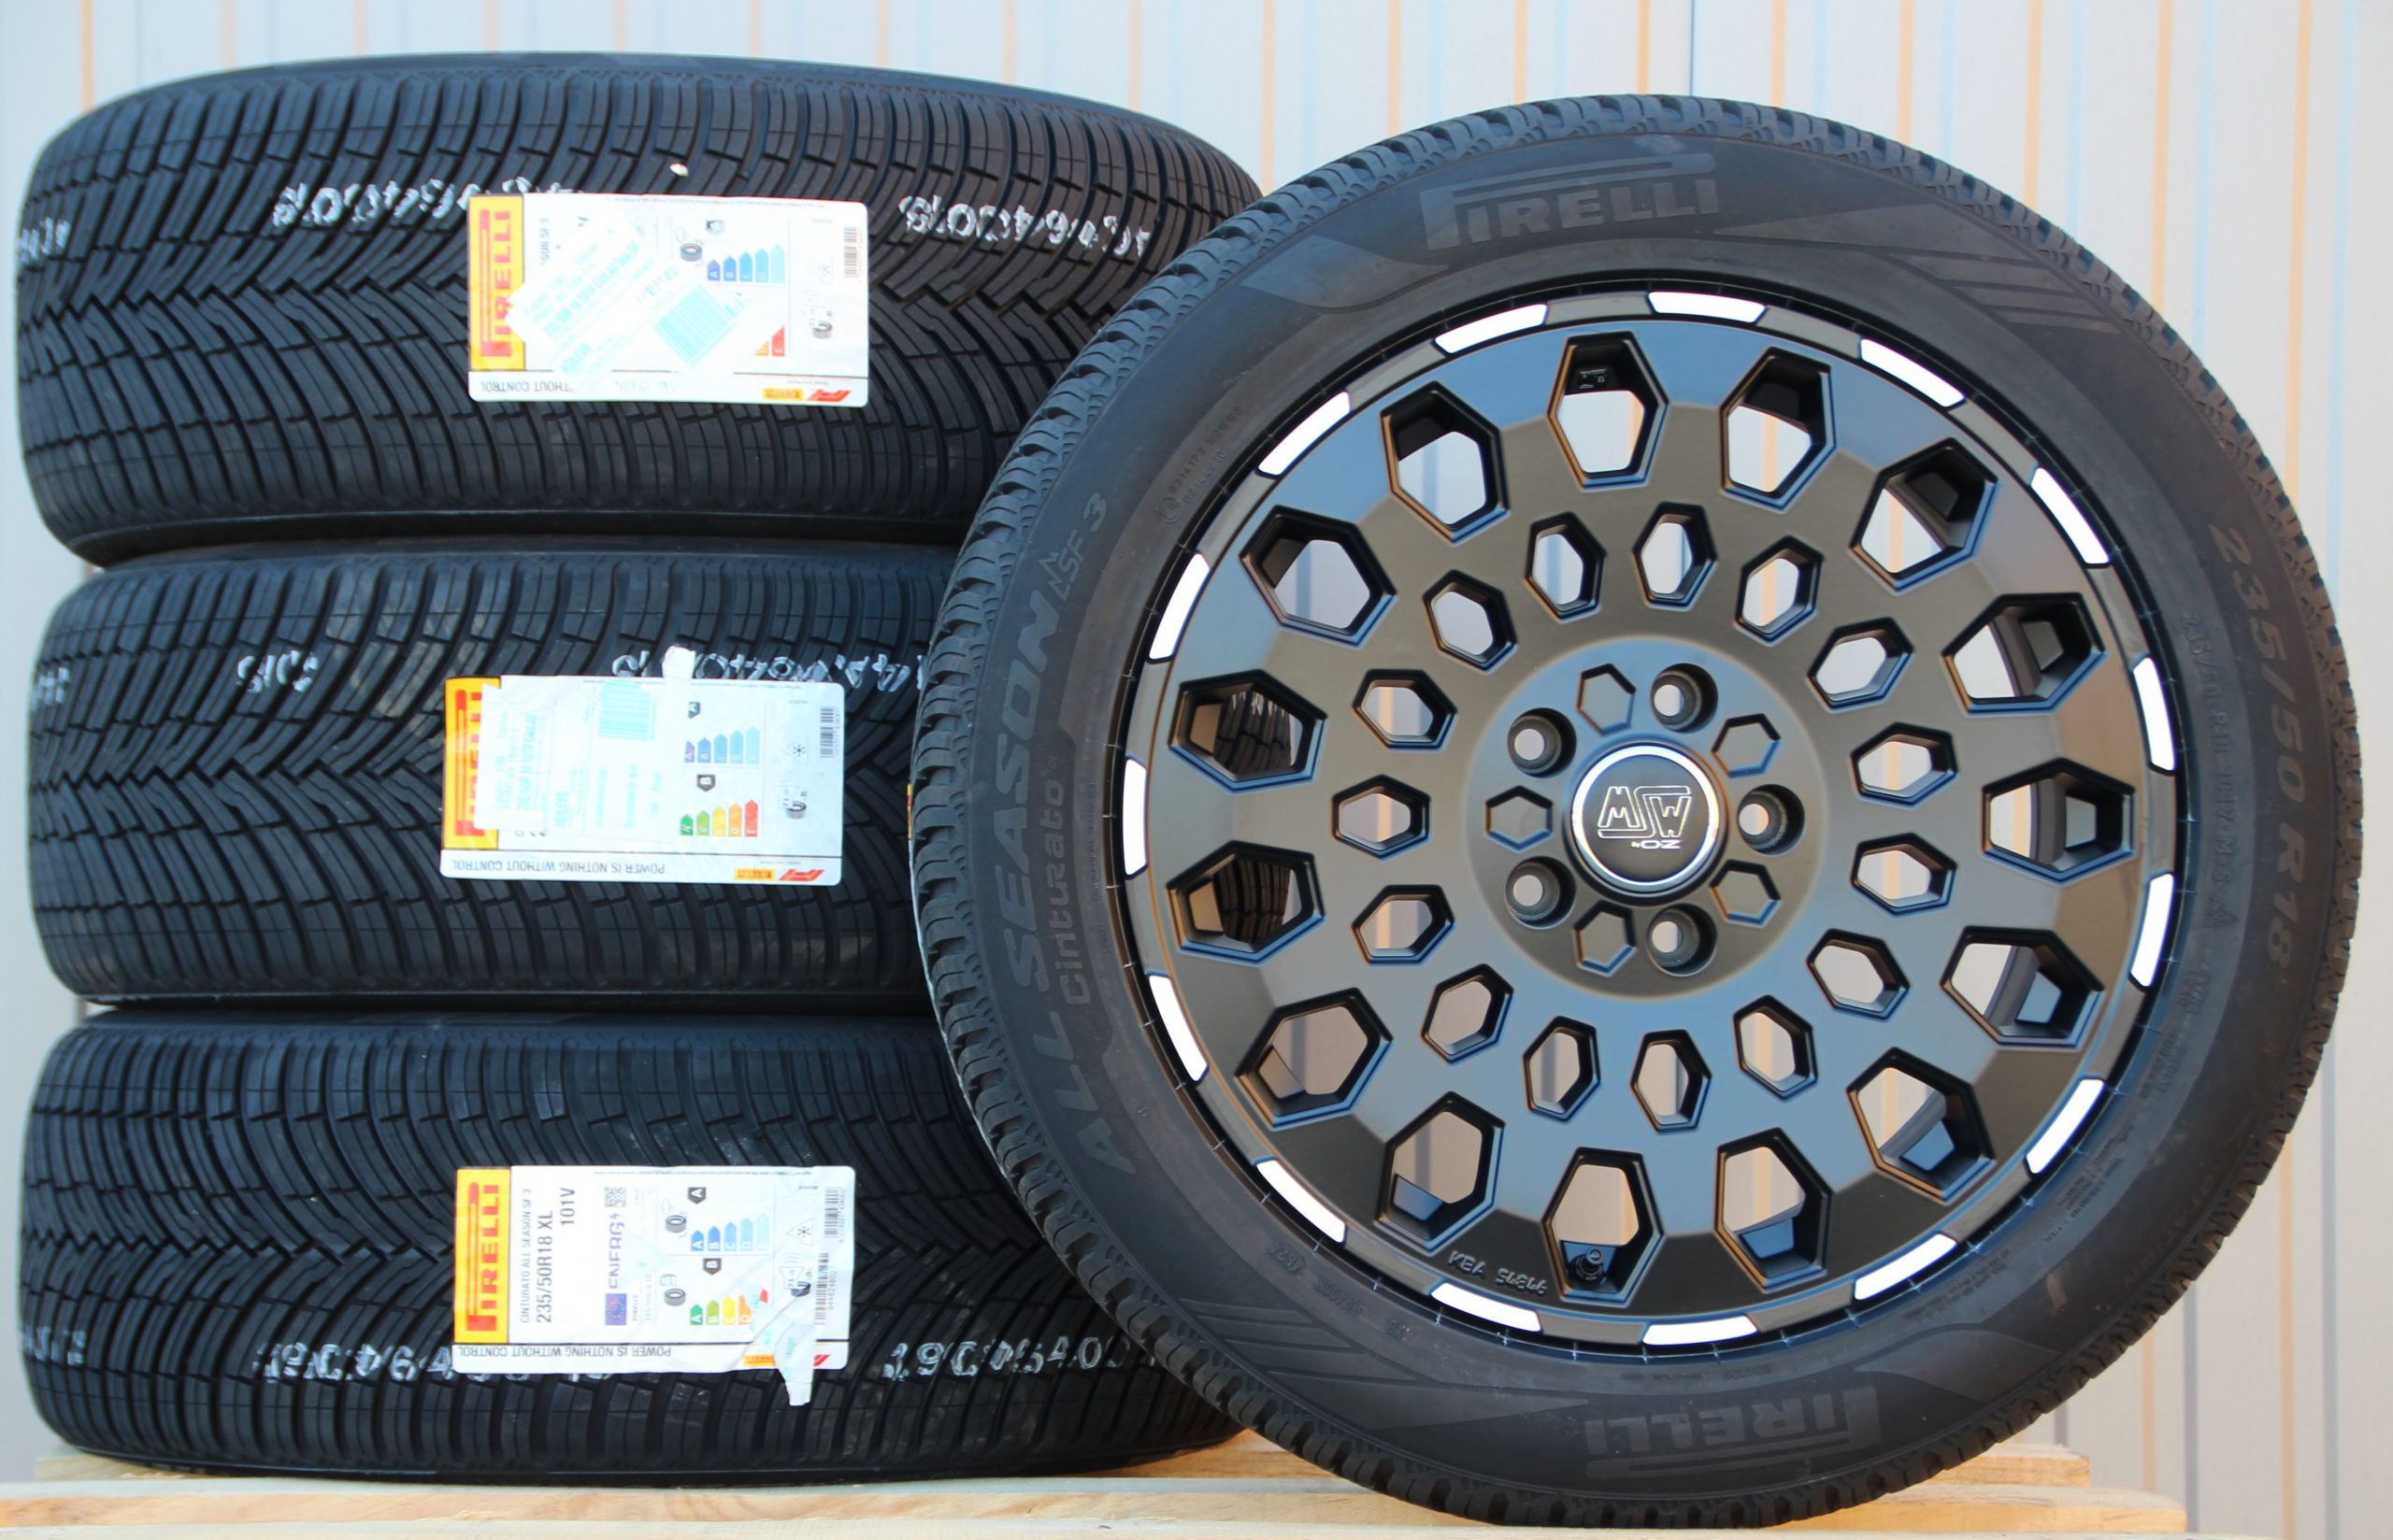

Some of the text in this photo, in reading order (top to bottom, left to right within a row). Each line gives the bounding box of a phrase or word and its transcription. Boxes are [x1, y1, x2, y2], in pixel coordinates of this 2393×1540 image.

[1418, 153, 1719, 251] PIRELLI
[479, 208, 511, 358] PIRELLI
[480, 381, 530, 392] CONTROL
[2207, 524, 2305, 803] 235/50
[700, 777, 712, 785] B
[1598, 785, 1692, 839] MSW
[993, 492, 1137, 1175] ALL SEASON SF 3
[1639, 840, 1682, 850] OZ
[451, 859, 666, 875] POWER IS NOTHING WITHOUT CONTROL
[691, 1189, 703, 1198] A
[521, 1196, 531, 1208] SF
[560, 1188, 576, 1227] 101V
[521, 1210, 531, 1248] SEASON
[692, 1240, 704, 1249] A
[709, 1241, 720, 1249] B
[725, 1241, 736, 1249] C
[466, 1181, 500, 1333] PIRELLI
[521, 1251, 531, 1268] ALL
[537, 1211, 553, 1323] 235/50R18 XL
[706, 1260, 719, 1269] B
[521, 1271, 531, 1323] CINTURATO
[692, 1314, 702, 1323] A
[709, 1315, 720, 1323] B
[724, 1315, 736, 1323] C
[457, 1346, 671, 1357] POWER IS NOTHING WITHOUT CONTROL
[1583, 1385, 1882, 1480] PIRELLI
